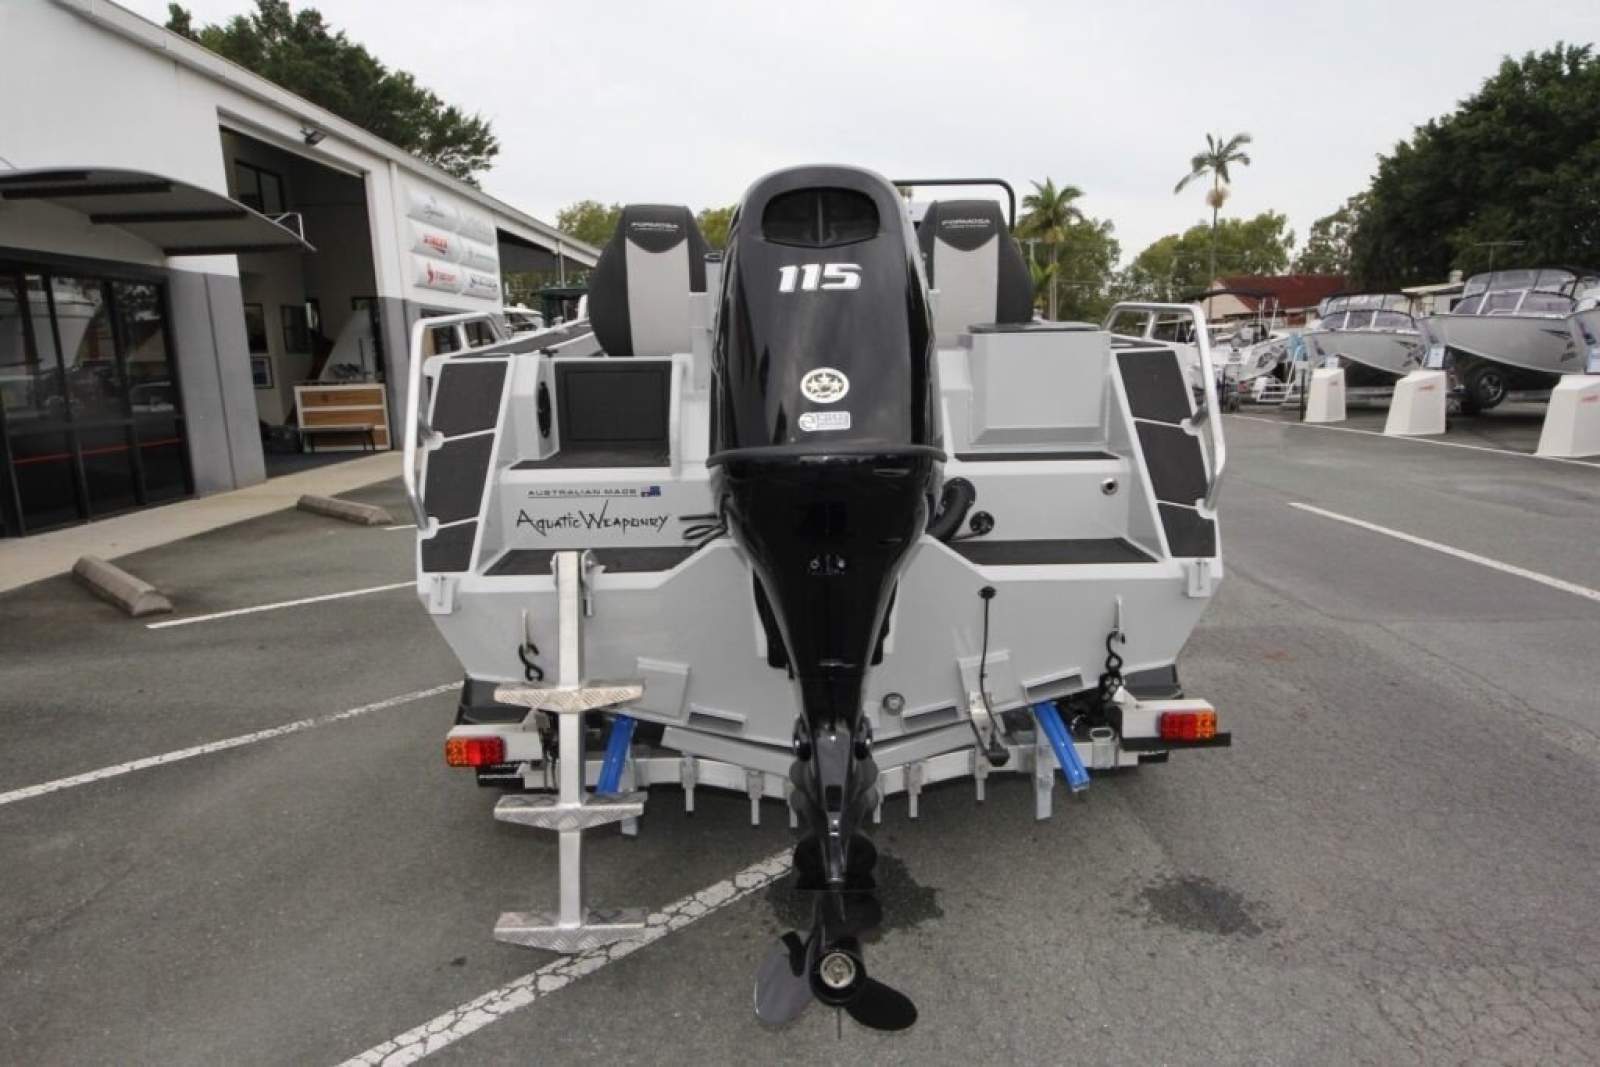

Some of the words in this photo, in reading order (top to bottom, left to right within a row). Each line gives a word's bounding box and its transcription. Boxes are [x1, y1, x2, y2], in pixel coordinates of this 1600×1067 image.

[778, 262, 863, 293] 115
[527, 488, 601, 496] AUSTRALIAN
[604, 488, 637, 496] MADE
